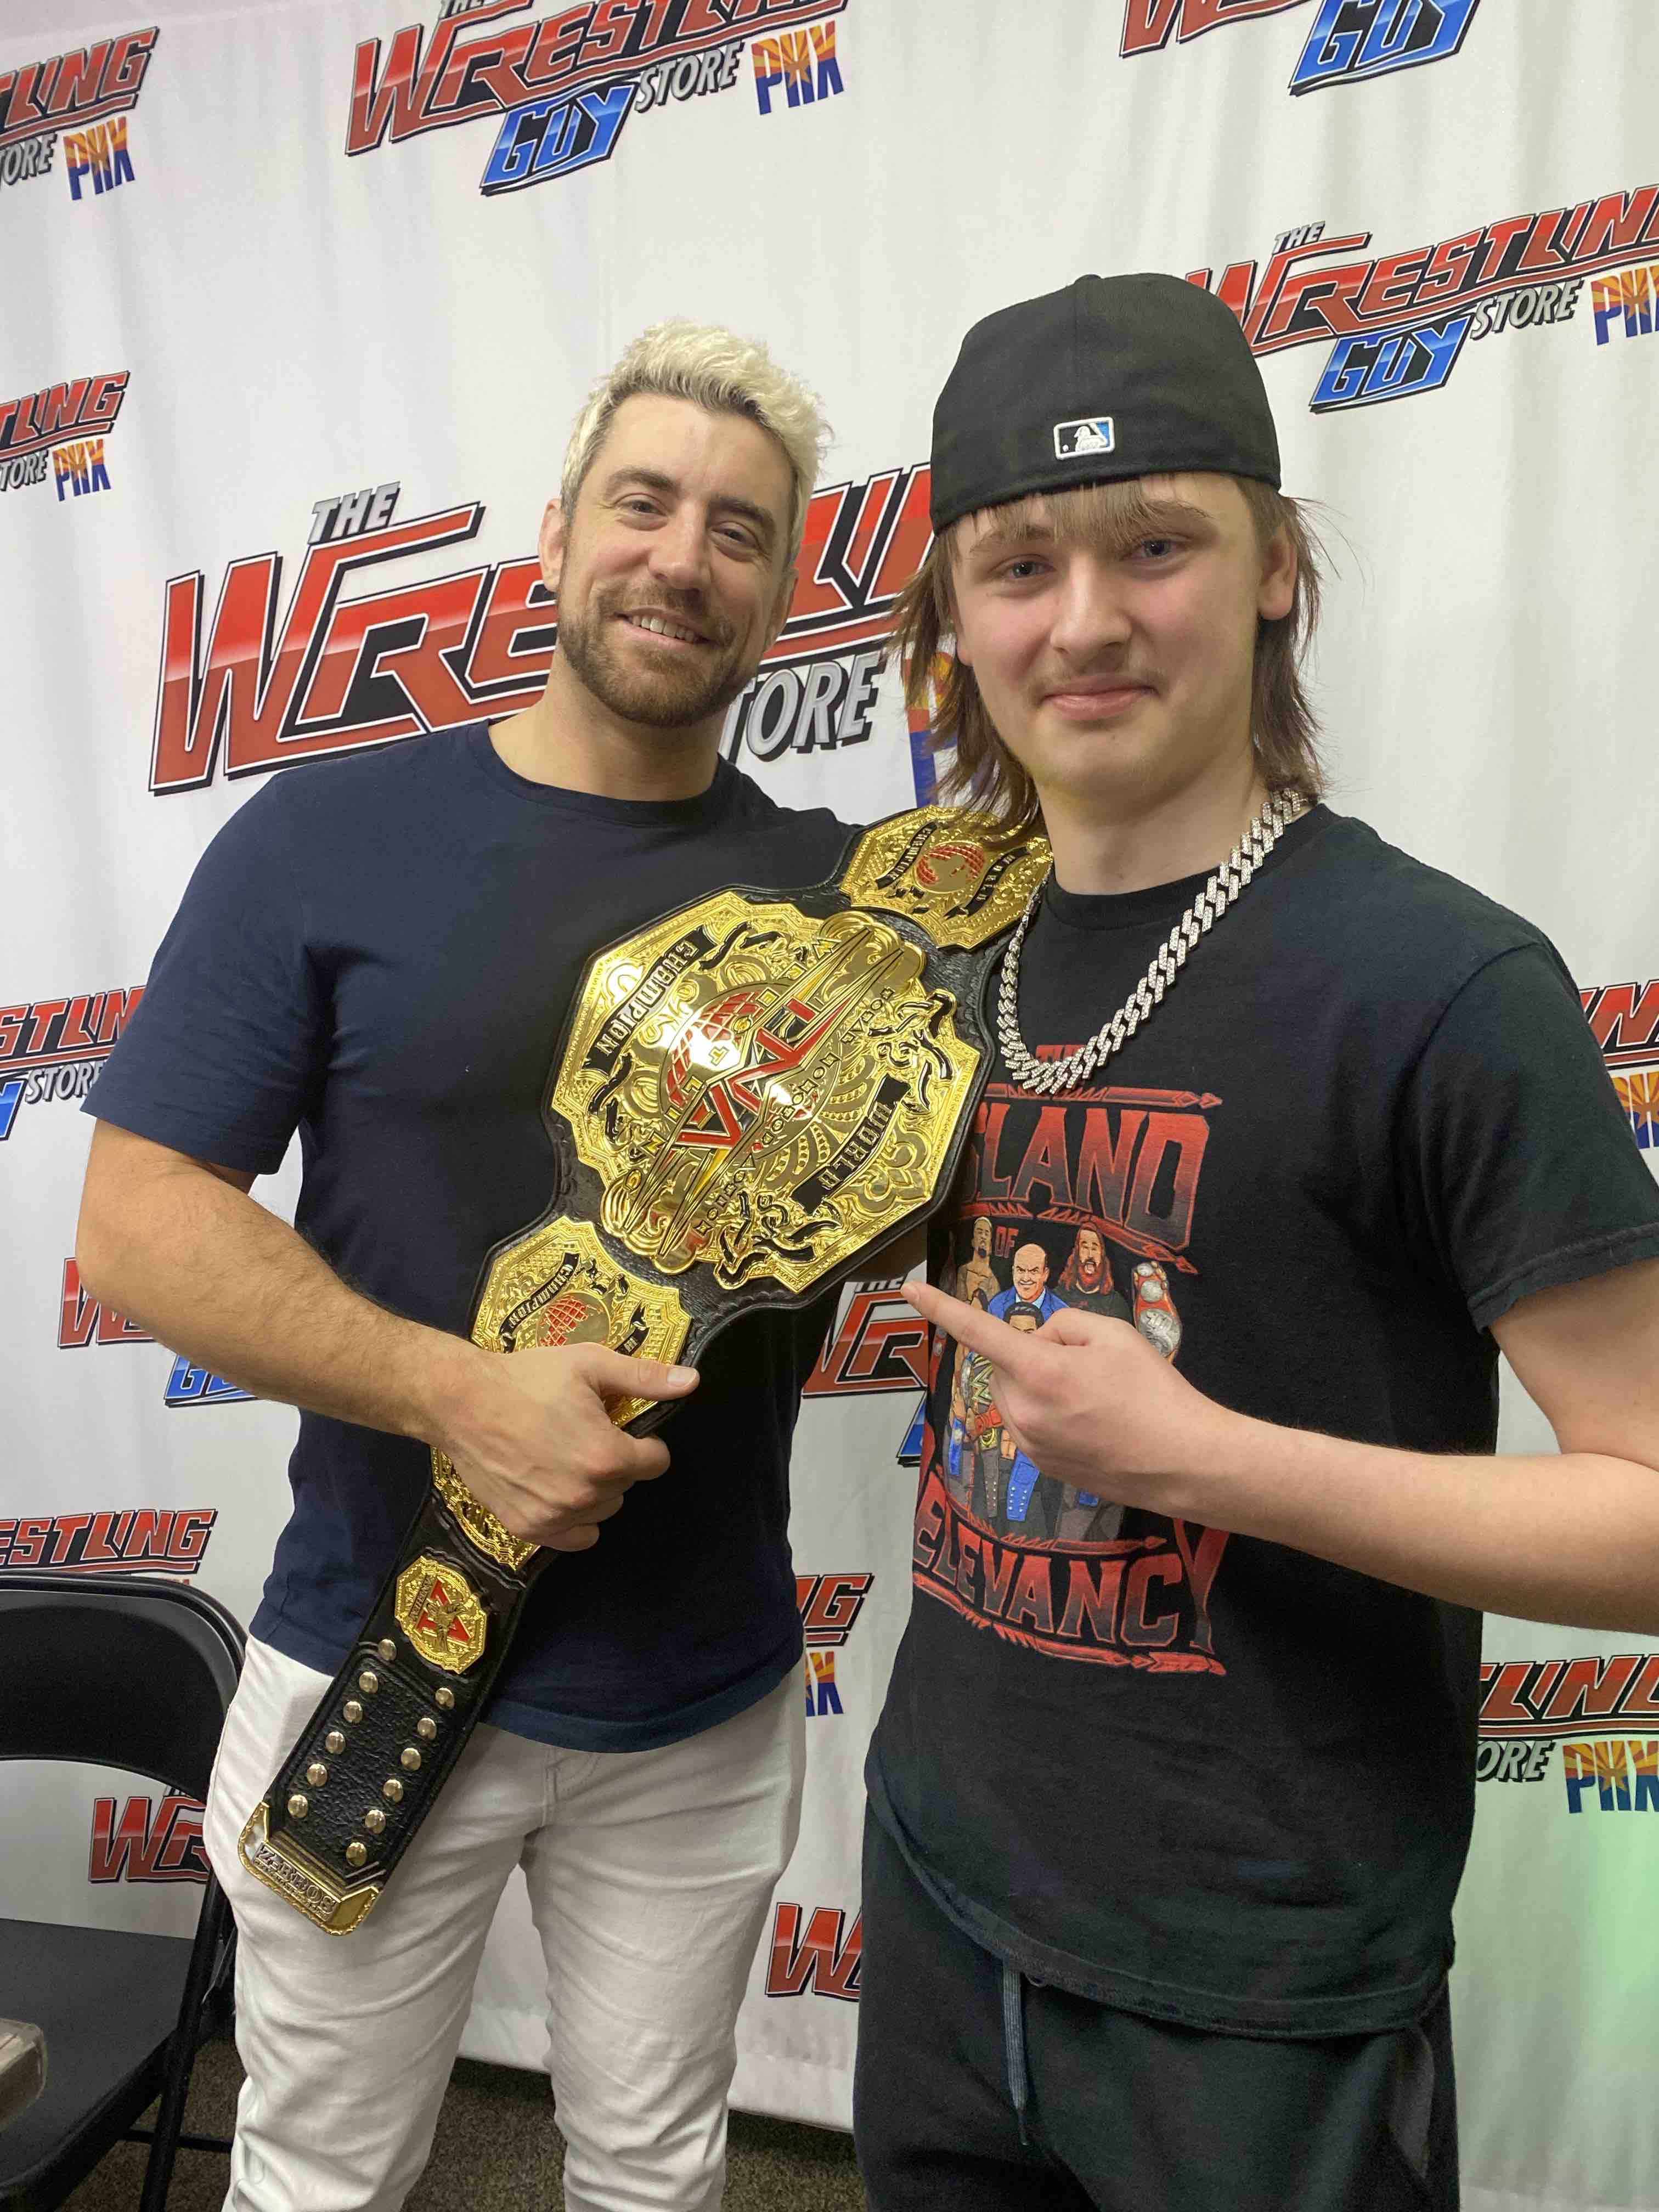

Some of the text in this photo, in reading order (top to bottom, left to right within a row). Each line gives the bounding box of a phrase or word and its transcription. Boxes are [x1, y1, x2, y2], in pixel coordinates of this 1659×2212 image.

[480, 20, 844, 195] GUY STORE PHX
[0, 116, 136, 201] ORE PHX
[1185, 183, 1659, 359] WRESTLIN
[1273, 221, 1325, 255] THE
[1309, 264, 1659, 414] GUY STORE PH
[52, 438, 111, 501] PHX
[308, 481, 401, 544] THE
[593, 937, 701, 1058] CHAMPION
[618, 938, 838, 1193] WRESTLING
[814, 1102, 894, 1194] WORLD
[995, 1226, 1019, 1259] OF
[507, 1263, 571, 1326] CHAMPION
[913, 1457, 1230, 1654] ELEVANCY
